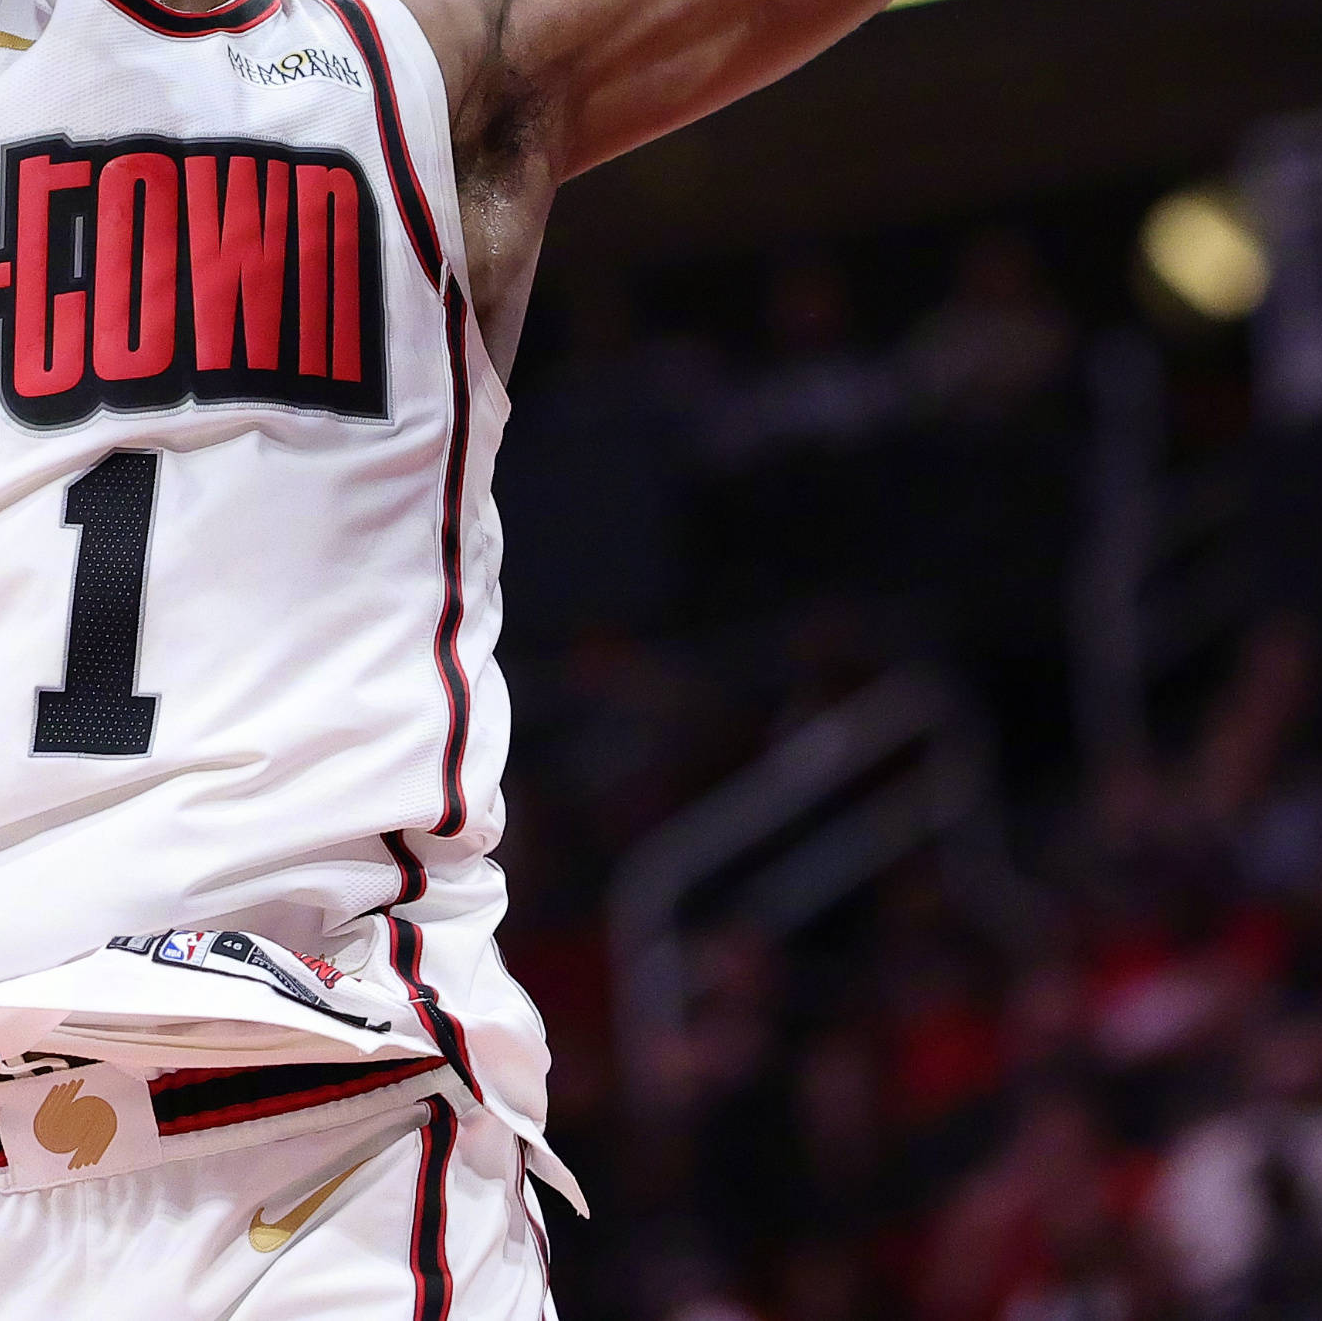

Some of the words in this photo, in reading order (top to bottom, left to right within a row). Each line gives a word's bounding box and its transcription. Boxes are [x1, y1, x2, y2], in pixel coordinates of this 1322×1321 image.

[227, 43, 359, 75] MEMORIAL
[231, 62, 362, 88] HERMANN
[29, 447, 163, 759] 1
